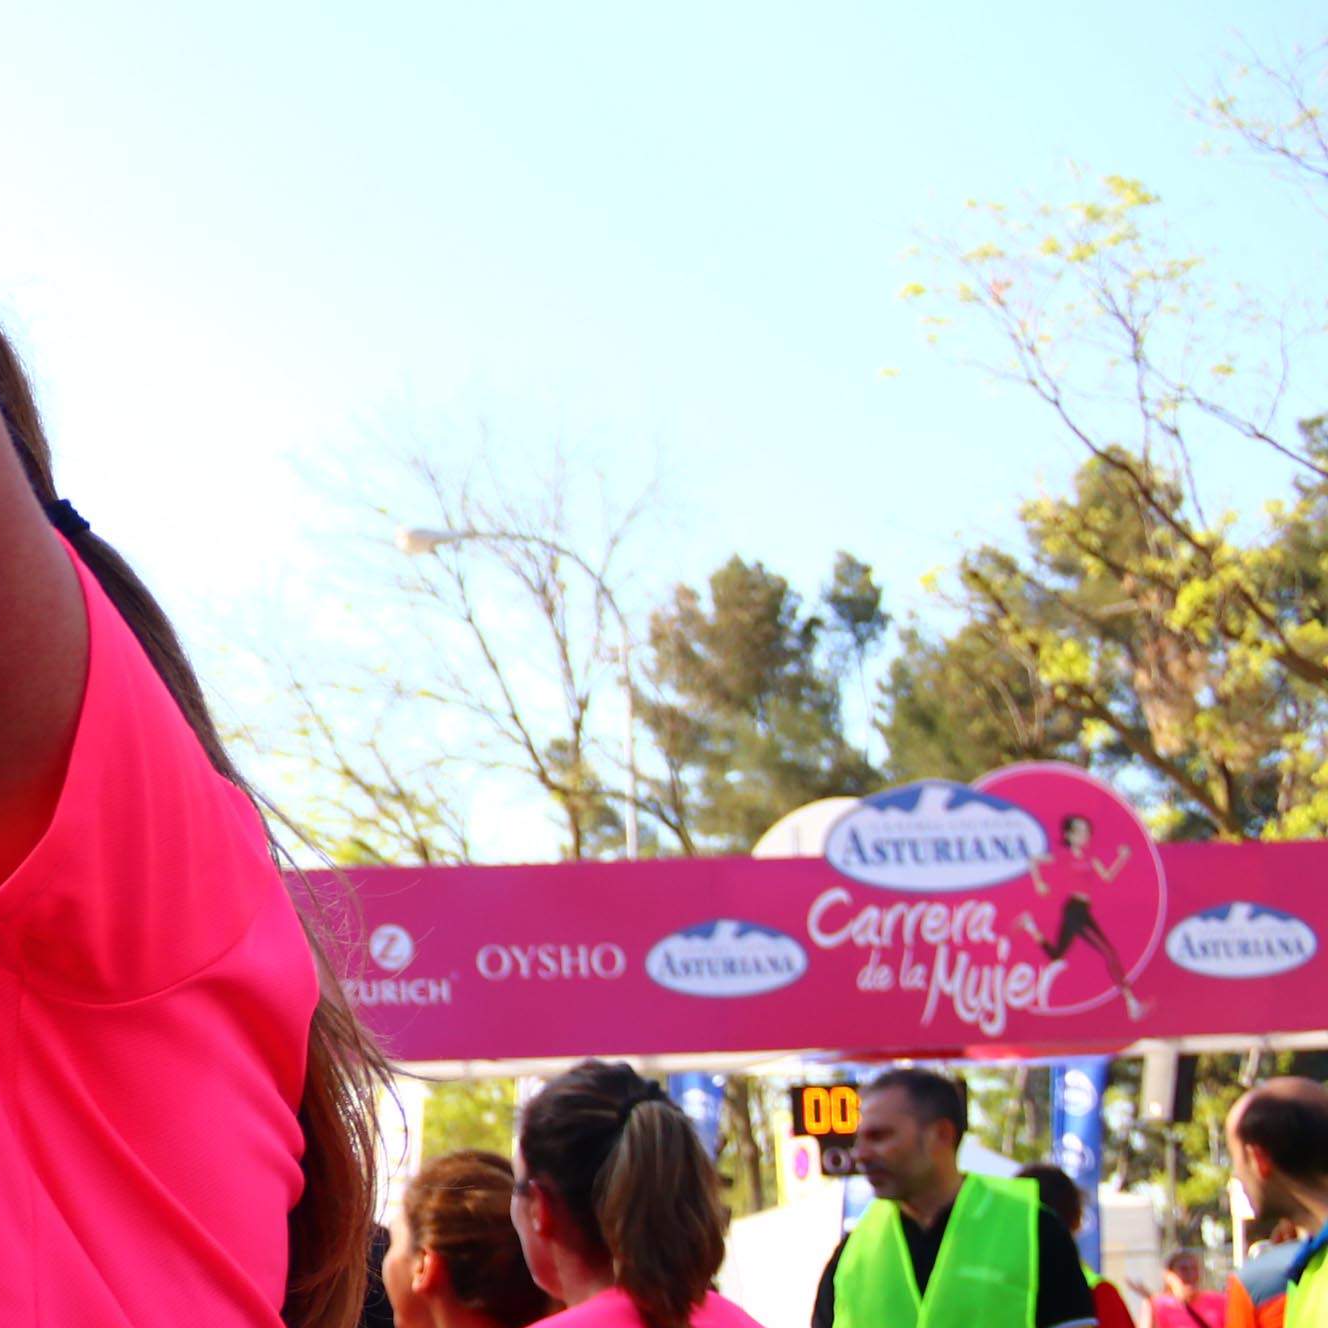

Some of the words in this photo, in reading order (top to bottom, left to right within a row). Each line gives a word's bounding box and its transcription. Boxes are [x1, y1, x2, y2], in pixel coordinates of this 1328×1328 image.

[844, 827, 1031, 867] ASTURIANA
[807, 886, 1003, 948] Carrera
[475, 942, 628, 981] OYSHO
[661, 951, 795, 977] ASTURIANA
[1180, 932, 1304, 958] ASTURIANA
[856, 948, 895, 992] de
[899, 944, 930, 990] la
[919, 938, 1070, 1037] Mujer
[803, 1086, 860, 1135] 00
